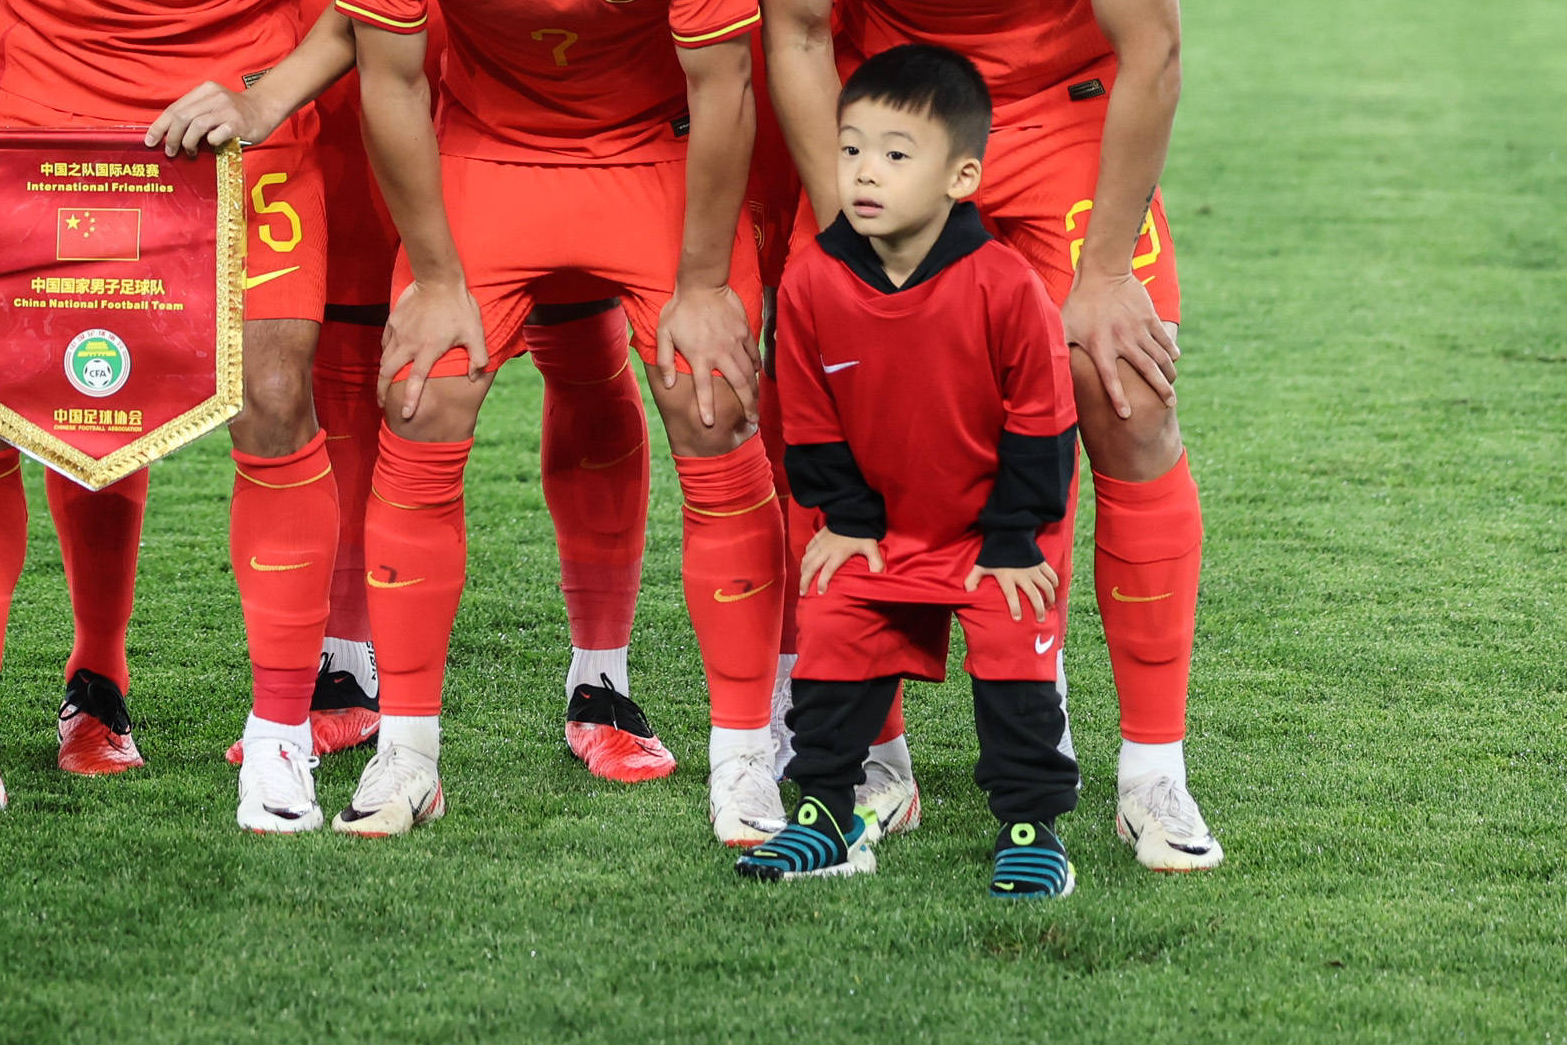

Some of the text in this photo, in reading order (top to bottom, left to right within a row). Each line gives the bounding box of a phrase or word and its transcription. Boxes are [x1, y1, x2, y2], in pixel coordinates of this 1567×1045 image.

[531, 28, 578, 67] 7
[40, 162, 160, 178] 中国之队国际A级赛
[26, 181, 174, 193] International Friendlies
[244, 172, 302, 256] 5
[31, 276, 166, 295] 中国国家男子足球队
[13, 298, 184, 311] China National Football Team
[89, 369, 107, 378] CFA
[54, 408, 143, 426] 中国足球协会
